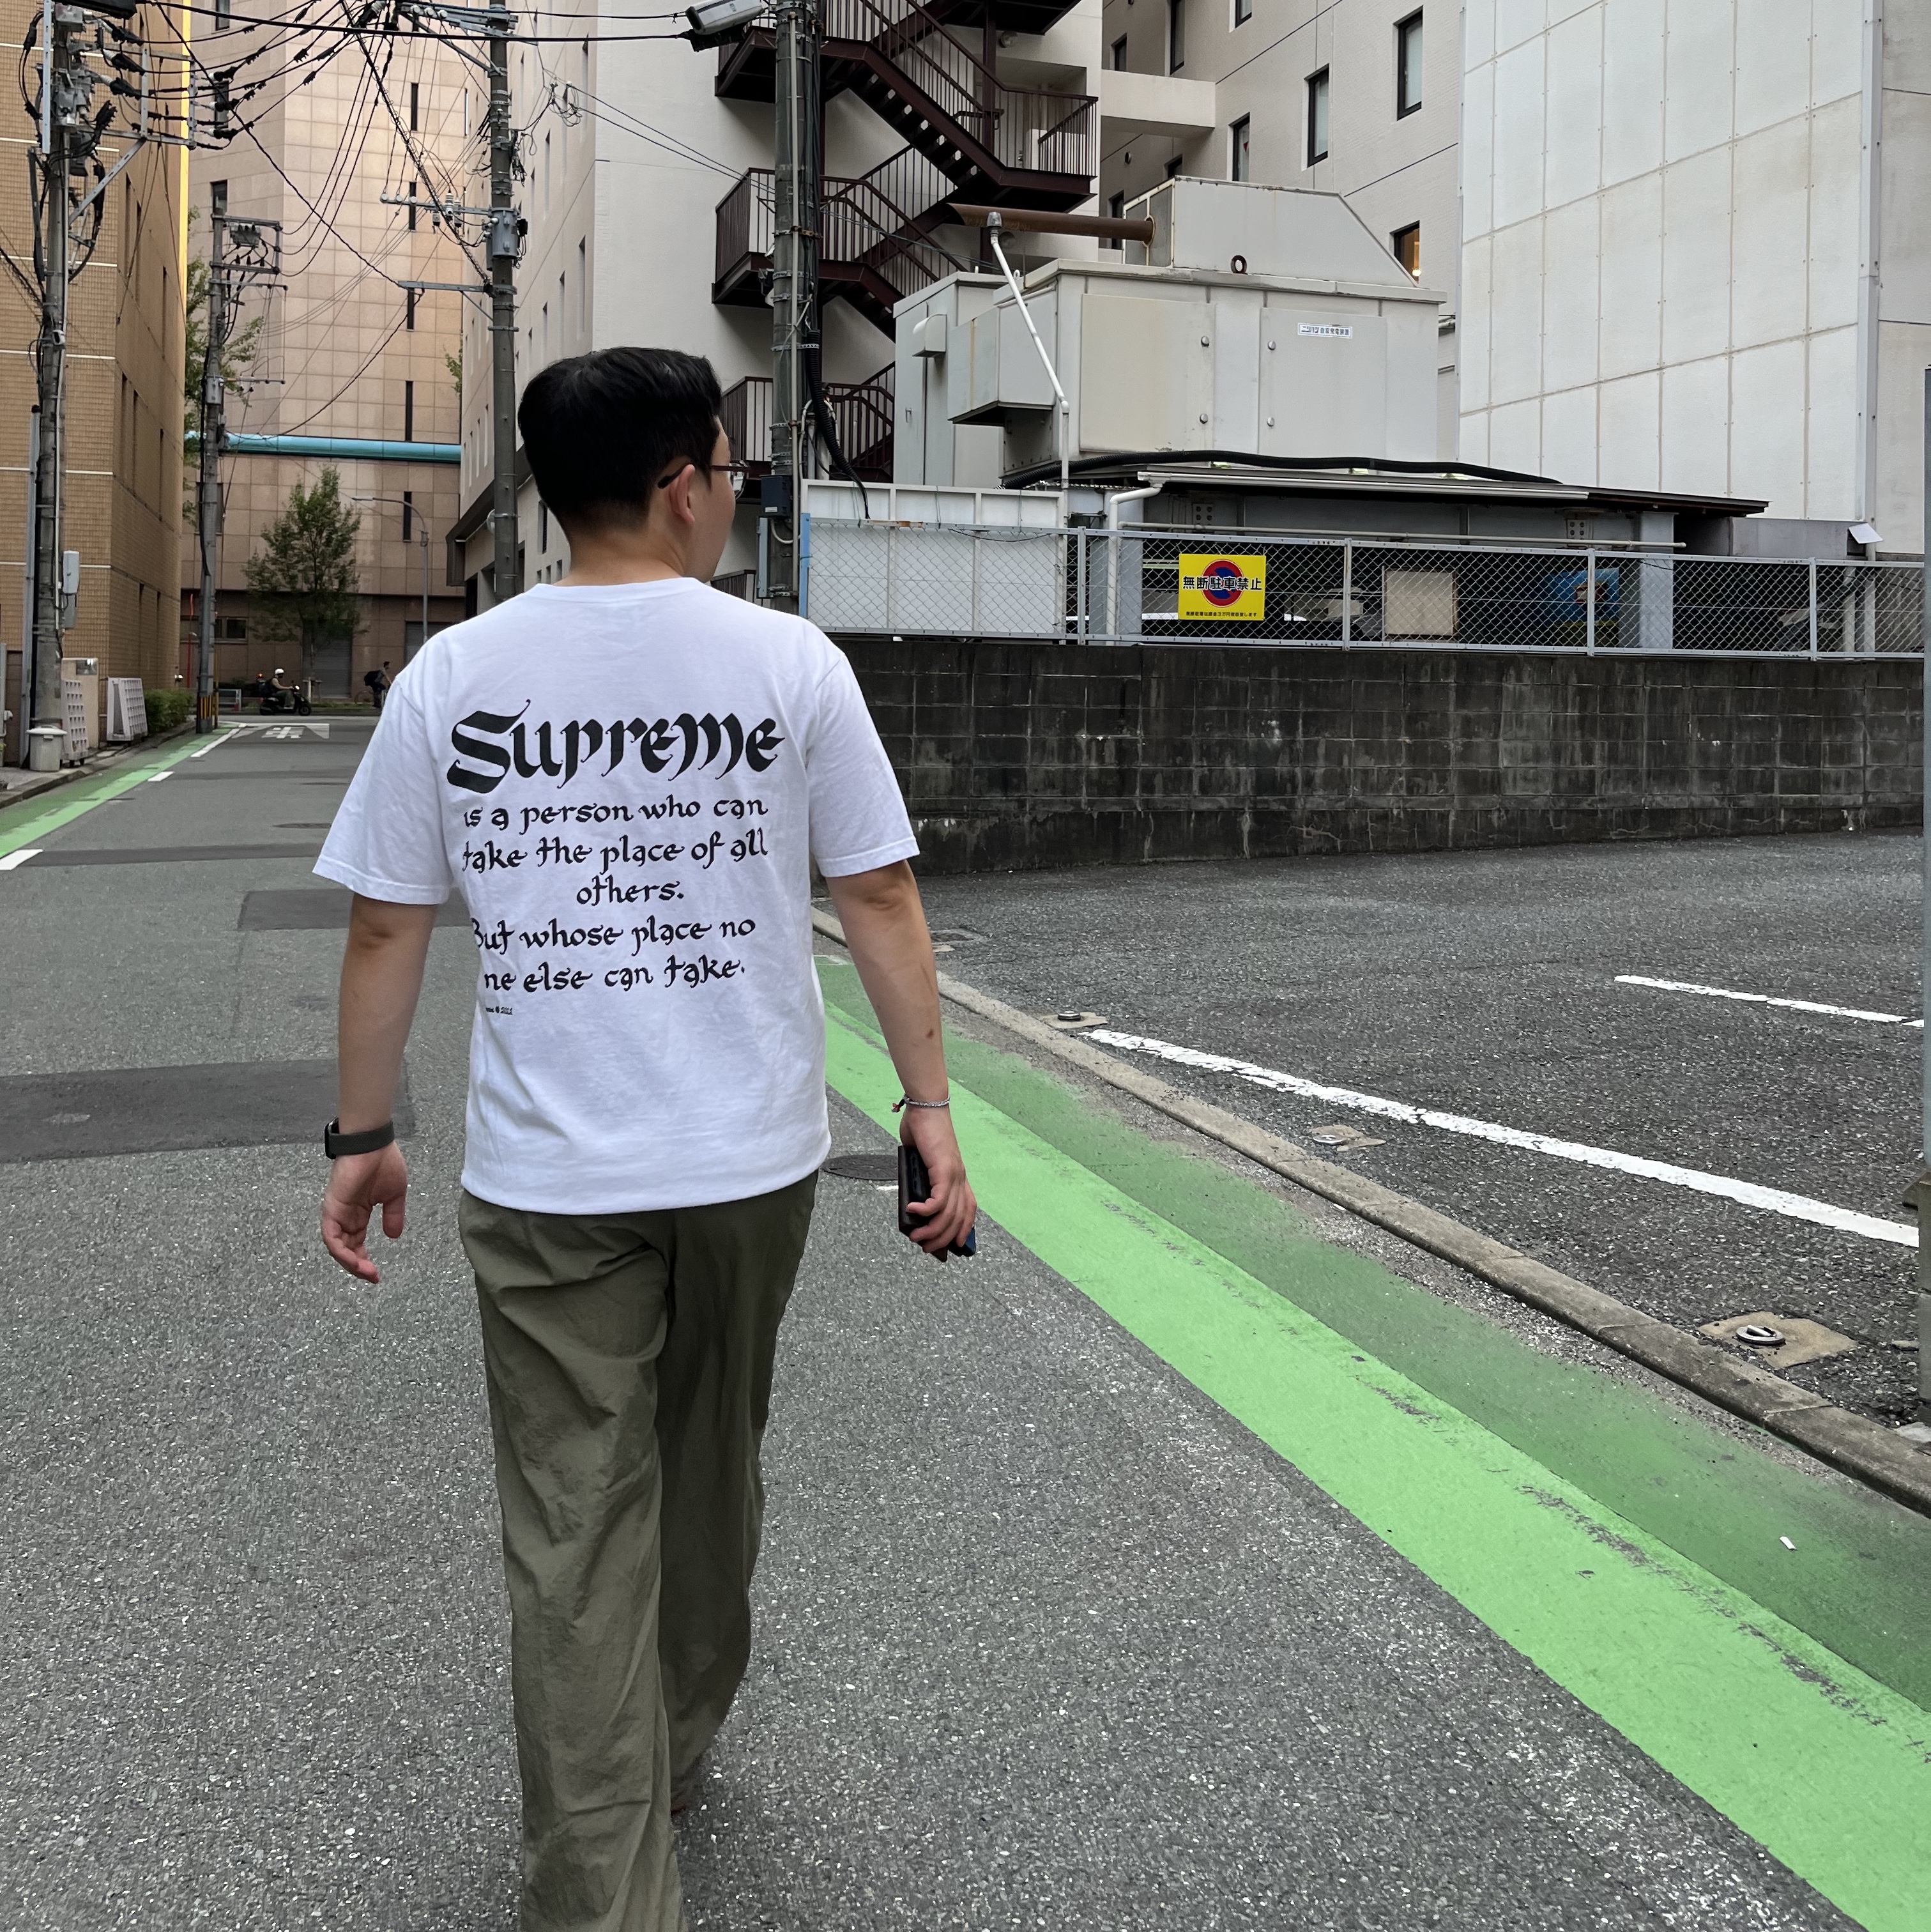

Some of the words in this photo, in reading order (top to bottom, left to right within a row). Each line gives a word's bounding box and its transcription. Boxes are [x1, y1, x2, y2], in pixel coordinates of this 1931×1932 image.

[1182, 576, 1262, 591] 無断駐車禁止
[446, 699, 786, 794] Supreme
[463, 806, 483, 827] is
[491, 808, 509, 831] a
[519, 802, 634, 836] person
[637, 793, 701, 820] who
[713, 798, 769, 820] can
[462, 840, 528, 874] take
[535, 836, 593, 868] the
[599, 834, 685, 875] place
[691, 831, 726, 870] of
[730, 827, 768, 862] all
[576, 875, 685, 907] others.
[519, 917, 624, 949] whose
[631, 915, 712, 956] place
[719, 919, 756, 938] no
[484, 972, 517, 992] ne
[523, 962, 593, 993] else
[604, 967, 654, 992] can
[664, 954, 746, 988] take.
